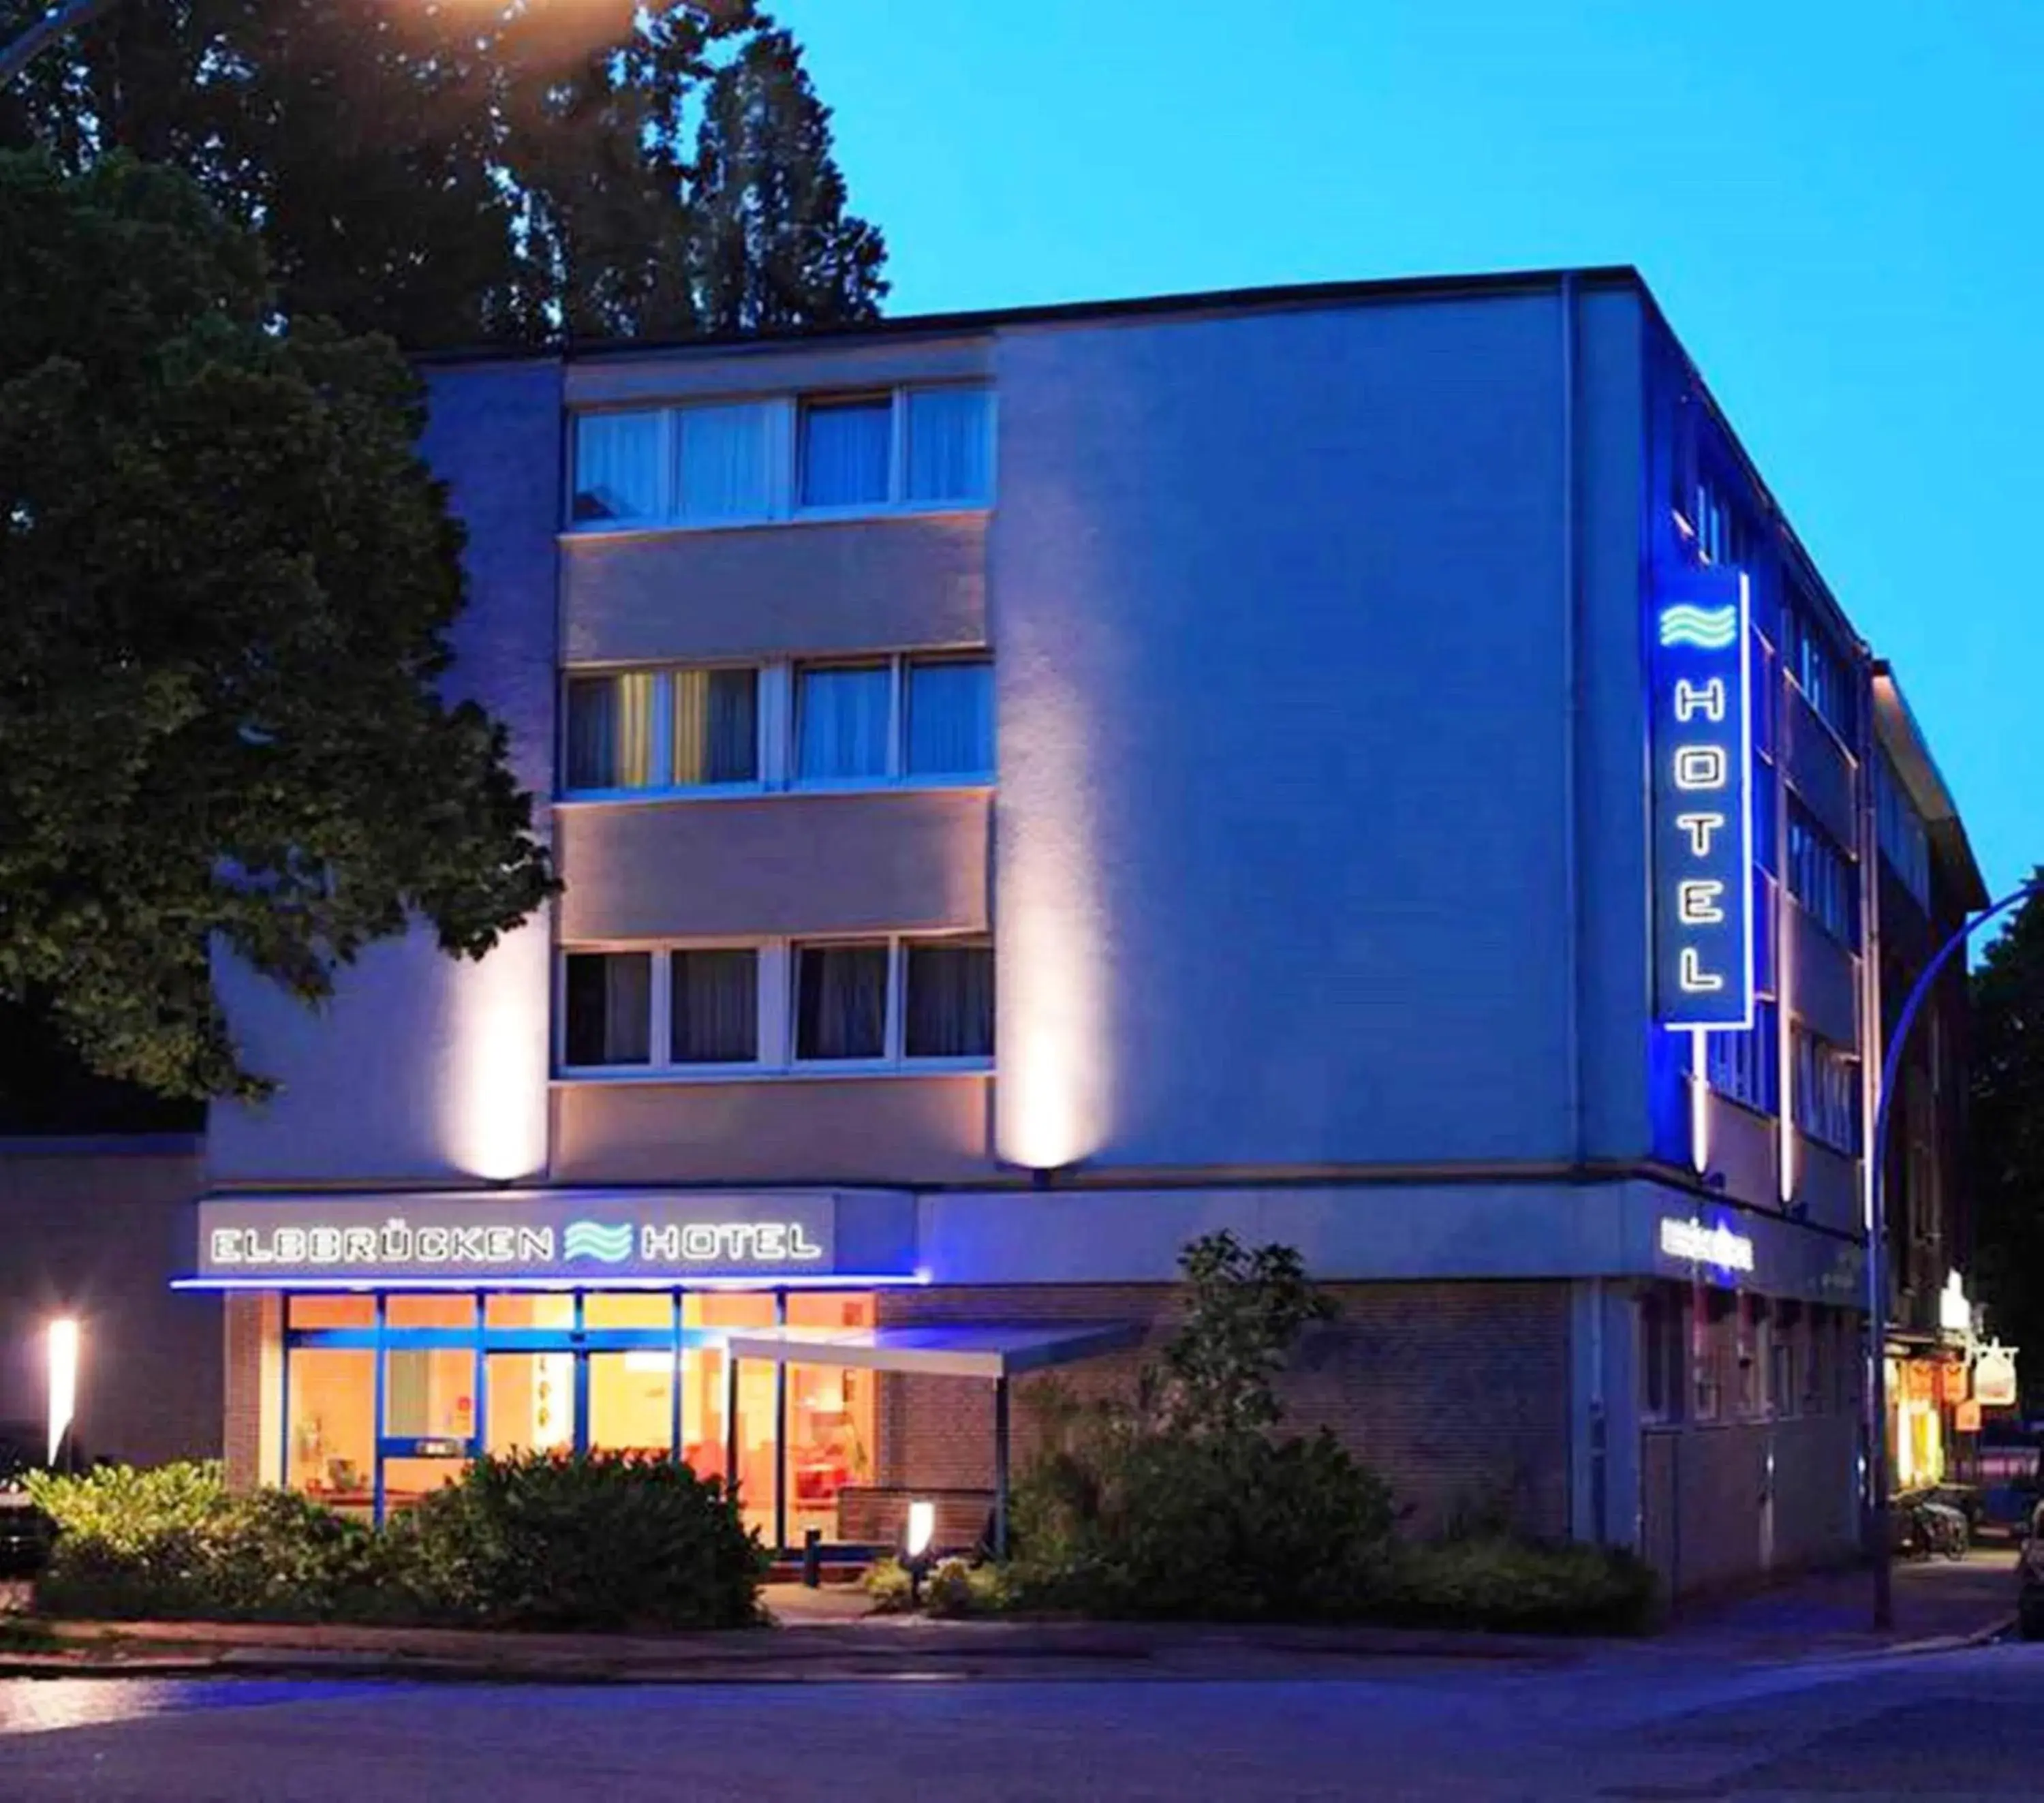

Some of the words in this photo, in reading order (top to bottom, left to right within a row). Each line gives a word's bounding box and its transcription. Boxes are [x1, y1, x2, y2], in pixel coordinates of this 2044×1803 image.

[1674, 679, 1725, 991] HOTEL
[211, 1218, 554, 1263] ELBBRÜCKEN
[641, 1222, 822, 1261] HOTEL
